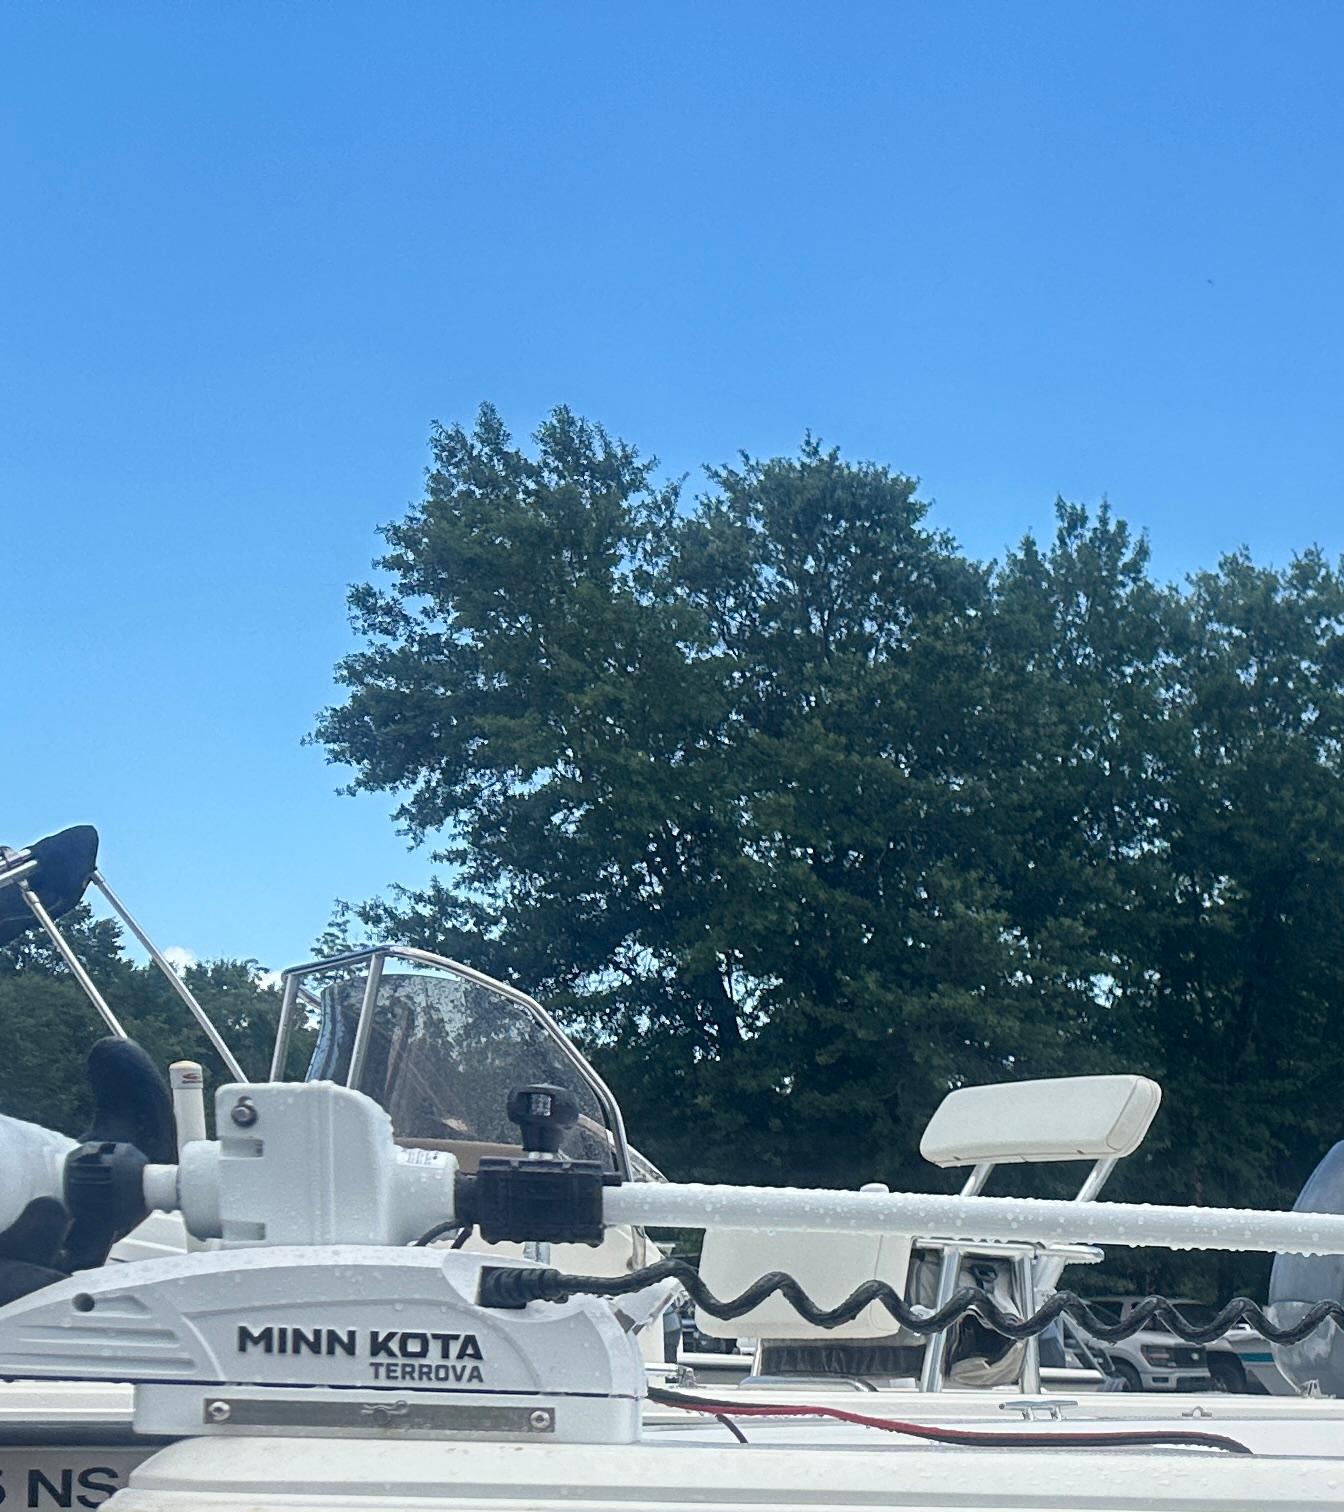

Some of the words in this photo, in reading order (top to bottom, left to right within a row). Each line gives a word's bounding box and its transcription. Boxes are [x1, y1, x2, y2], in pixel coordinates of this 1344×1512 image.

[237, 1325, 357, 1356] MINN
[369, 1330, 484, 1360] KOTA
[369, 1362, 484, 1383] TERROVA
